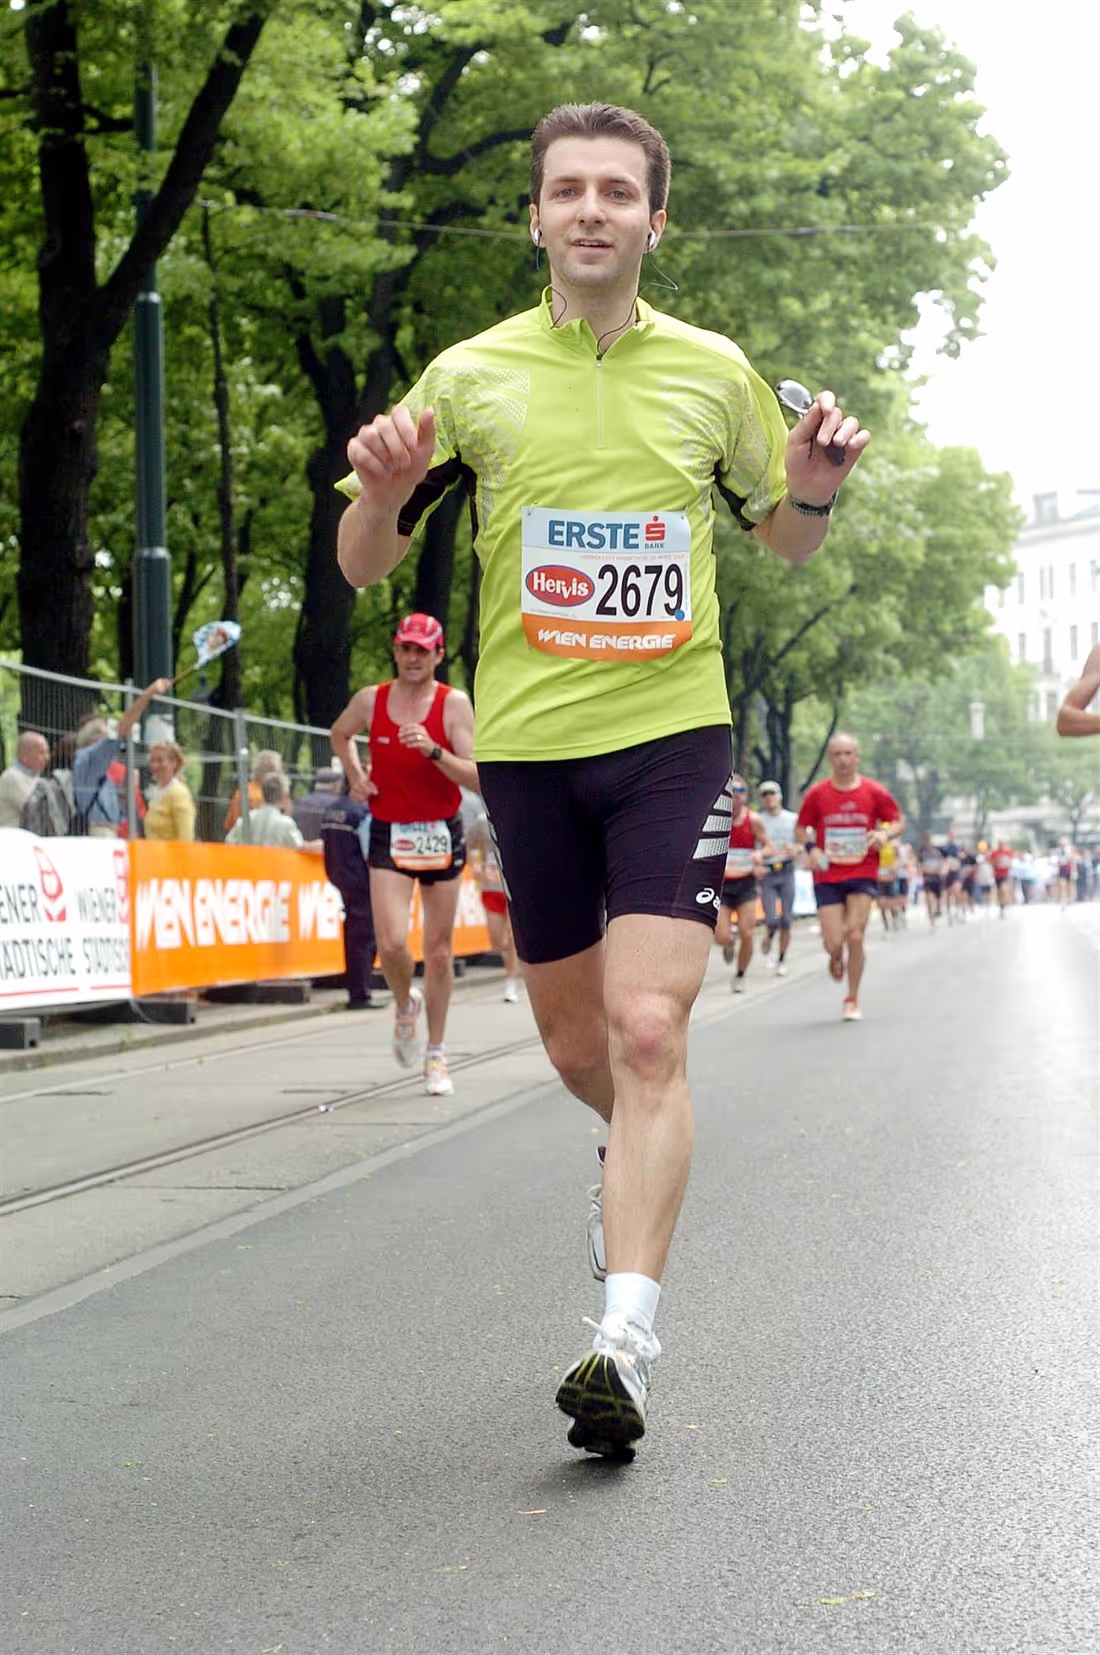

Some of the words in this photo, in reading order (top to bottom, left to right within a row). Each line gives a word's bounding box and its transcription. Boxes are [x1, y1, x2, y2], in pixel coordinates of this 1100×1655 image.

[548, 519, 640, 549] ERSTE
[533, 571, 589, 599] Hervis
[595, 563, 683, 617] 2679
[538, 628, 586, 648] WIEN
[589, 633, 676, 650] ENERGIE
[195, 879, 292, 947] ENERGIE
